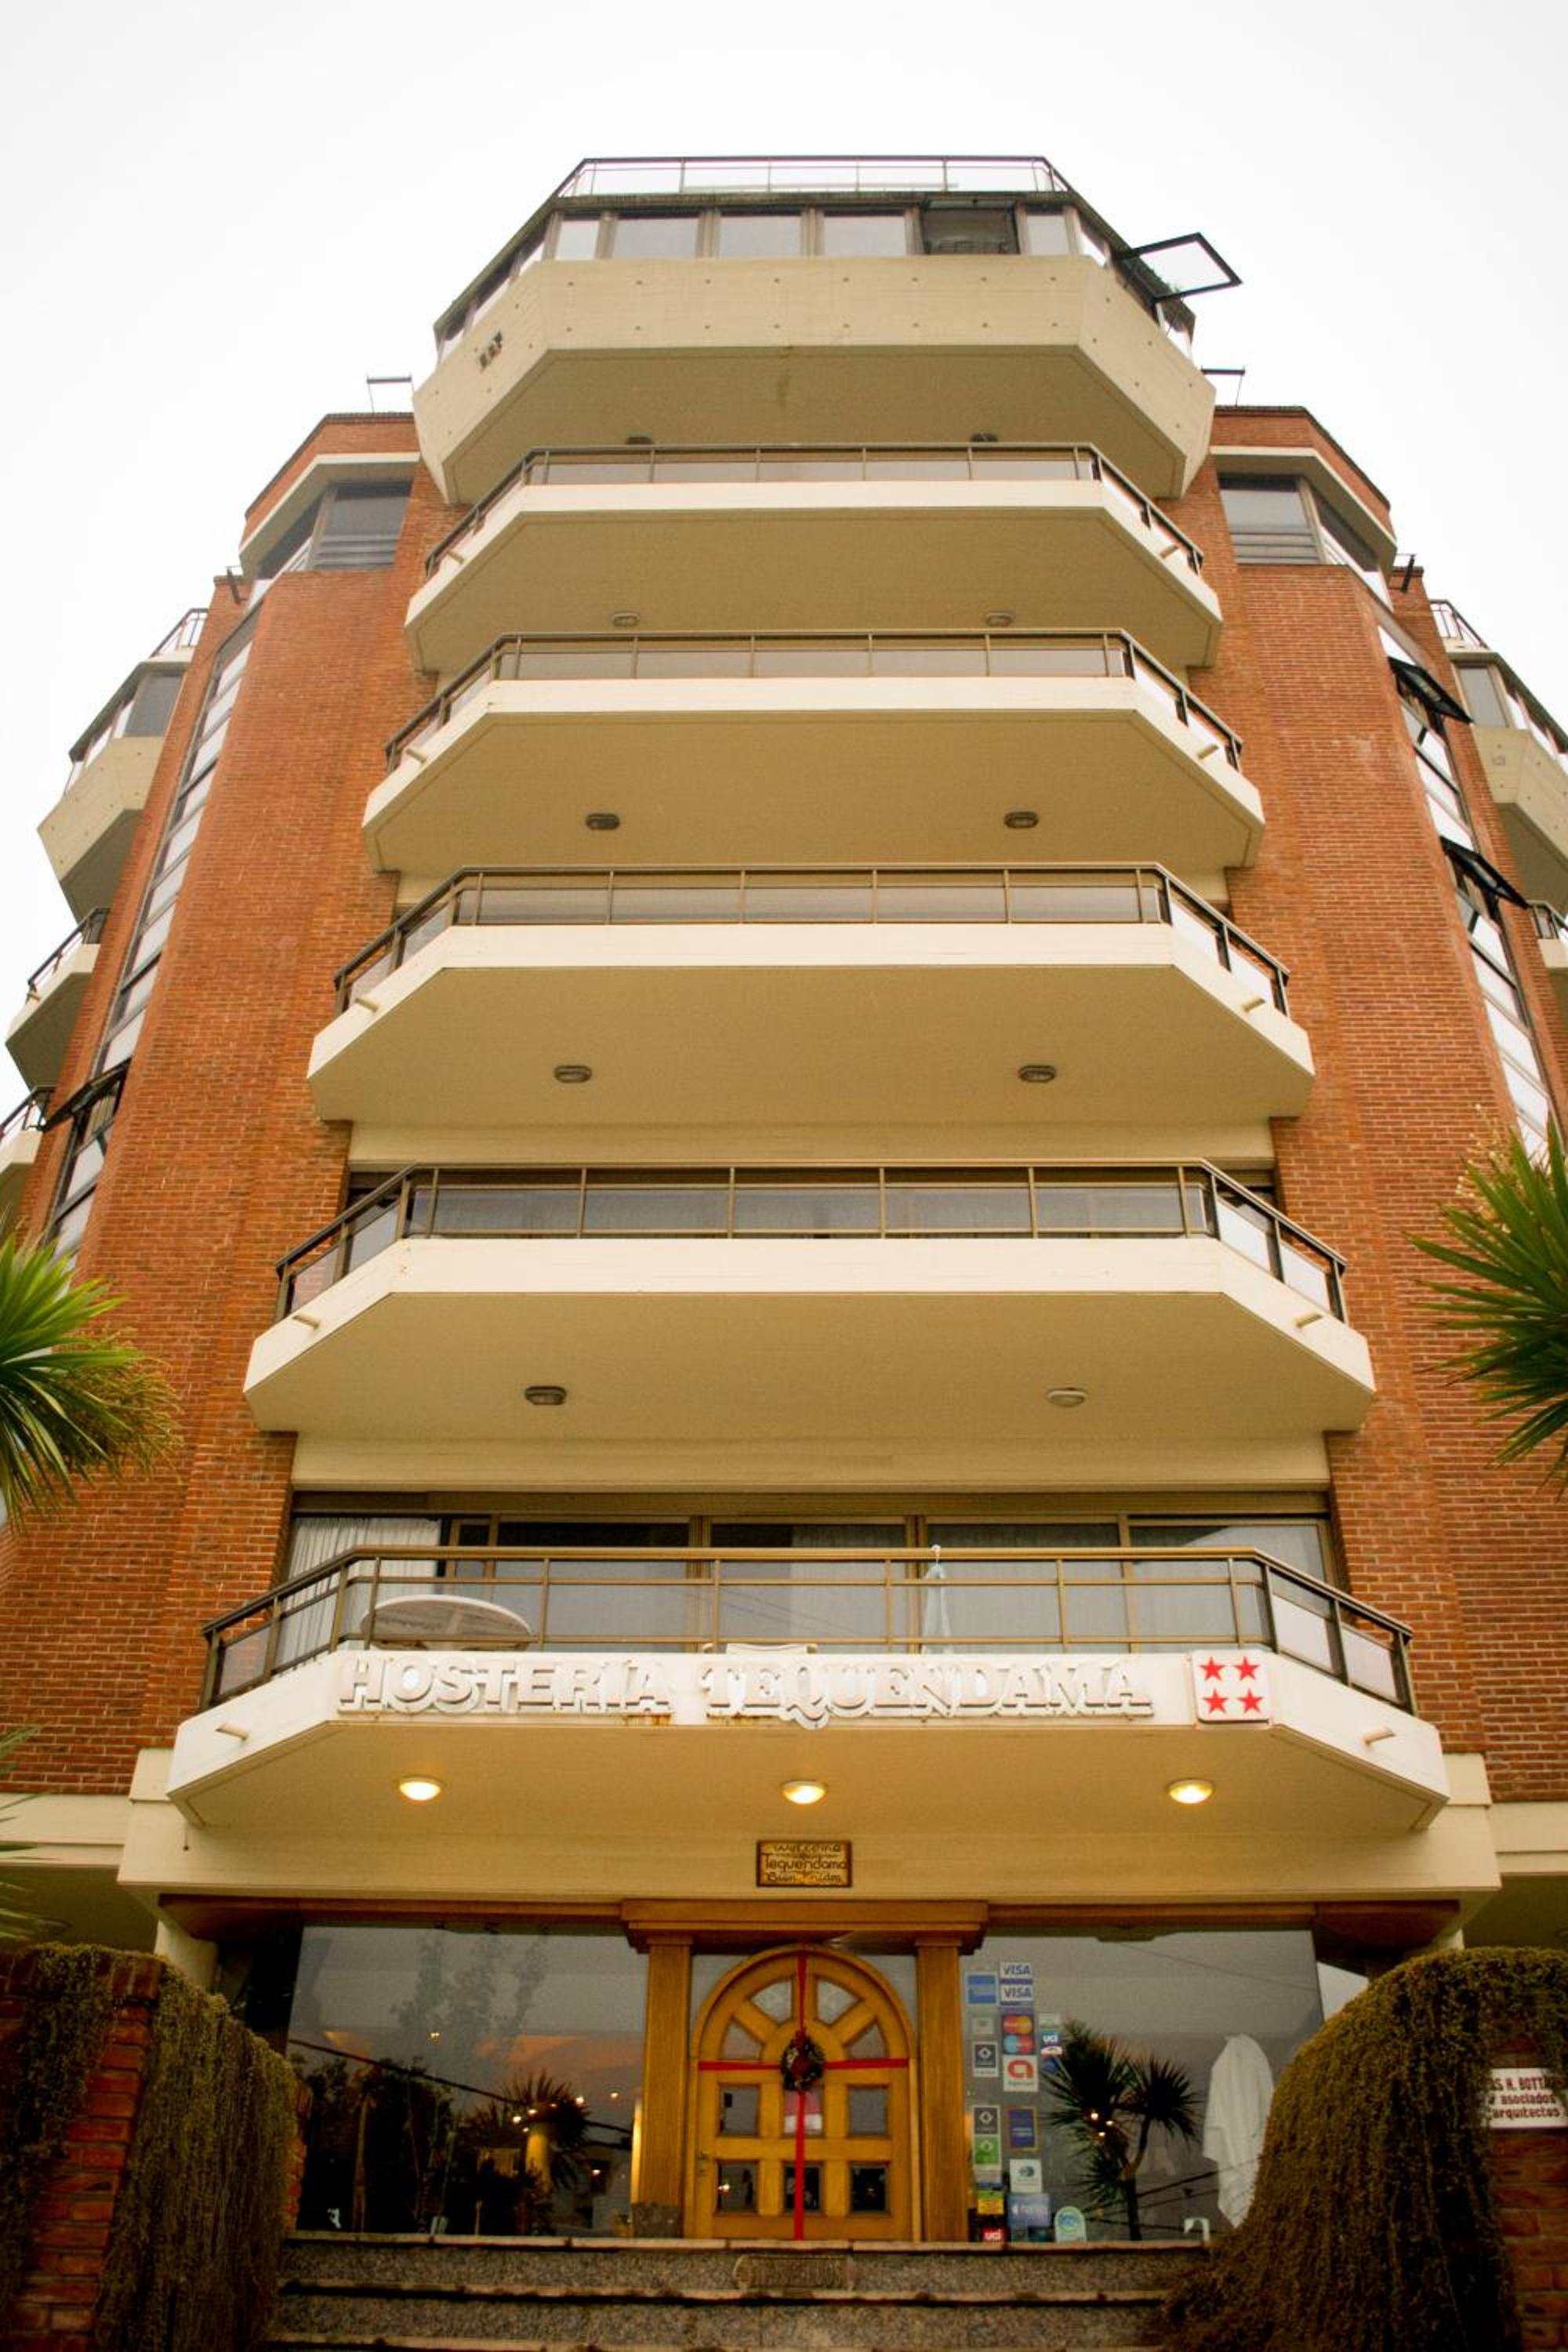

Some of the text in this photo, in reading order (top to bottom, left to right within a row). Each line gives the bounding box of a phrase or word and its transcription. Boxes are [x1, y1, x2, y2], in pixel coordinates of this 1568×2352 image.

[339, 1654, 1155, 1728] HOSTERIA TEQUENDAMA
[1003, 1965, 1031, 1975] VISA
[1004, 1987, 1032, 1998] VISA
